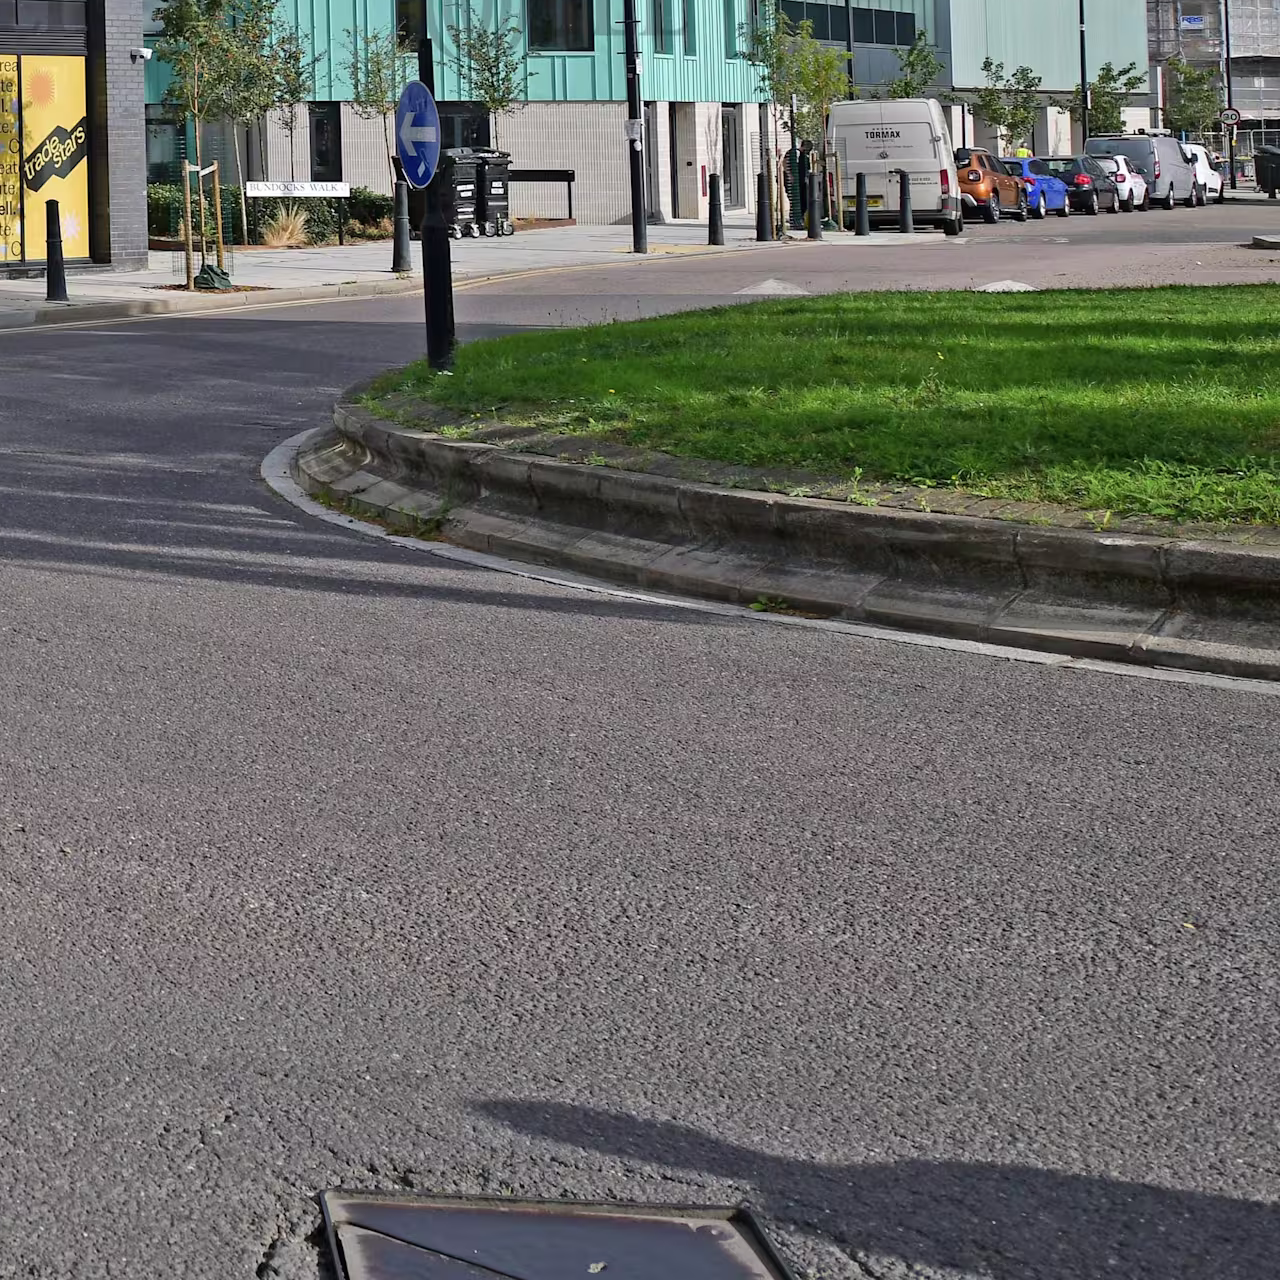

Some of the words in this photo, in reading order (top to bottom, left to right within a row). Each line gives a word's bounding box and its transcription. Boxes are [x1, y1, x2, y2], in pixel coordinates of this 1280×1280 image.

[865, 130, 900, 139] TORMAX
[24, 136, 59, 180] trade
[53, 127, 85, 168] stars
[250, 183, 305, 192] BUNDOCKS
[310, 183, 338, 192] WALK
